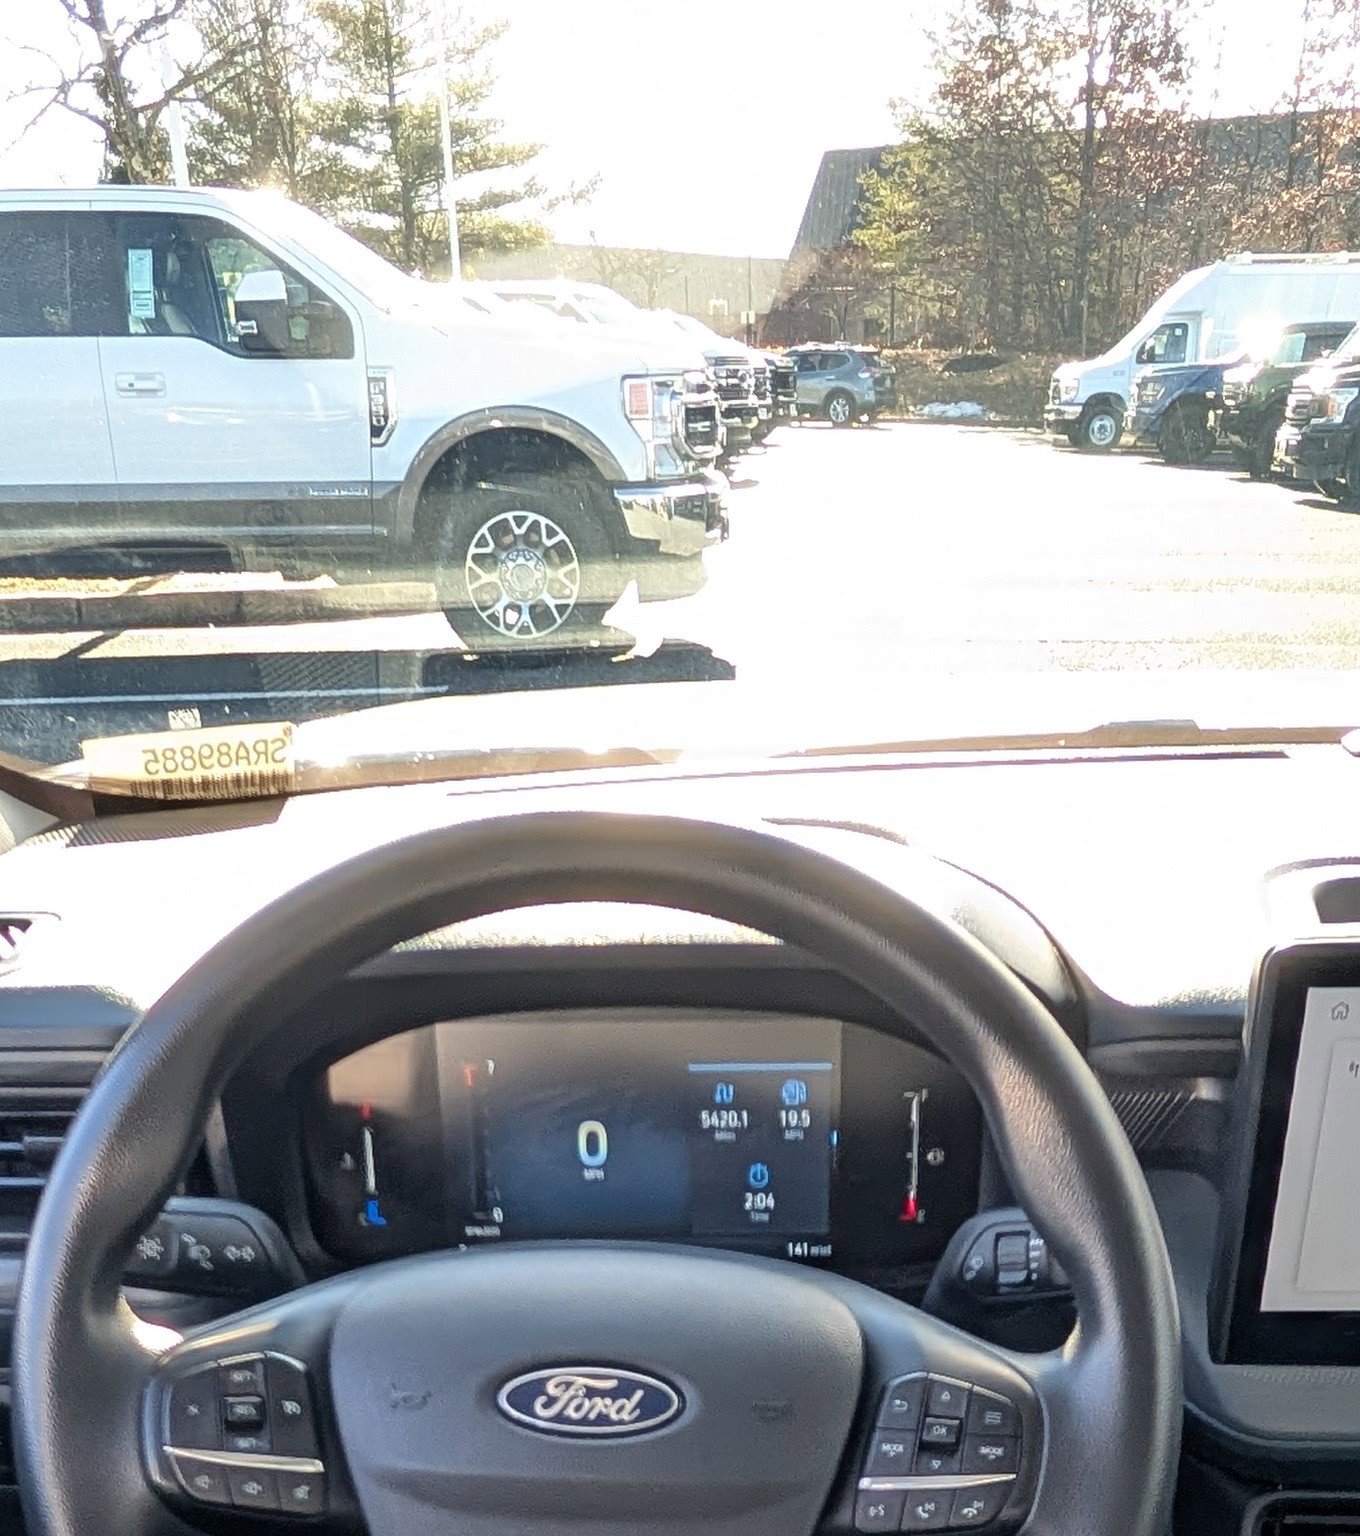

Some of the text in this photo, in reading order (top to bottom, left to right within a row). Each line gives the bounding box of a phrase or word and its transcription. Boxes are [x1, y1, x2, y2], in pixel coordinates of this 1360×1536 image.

[577, 1120, 608, 1167] 0
[534, 1375, 643, 1422] Ford
[932, 1424, 949, 1435] OK
